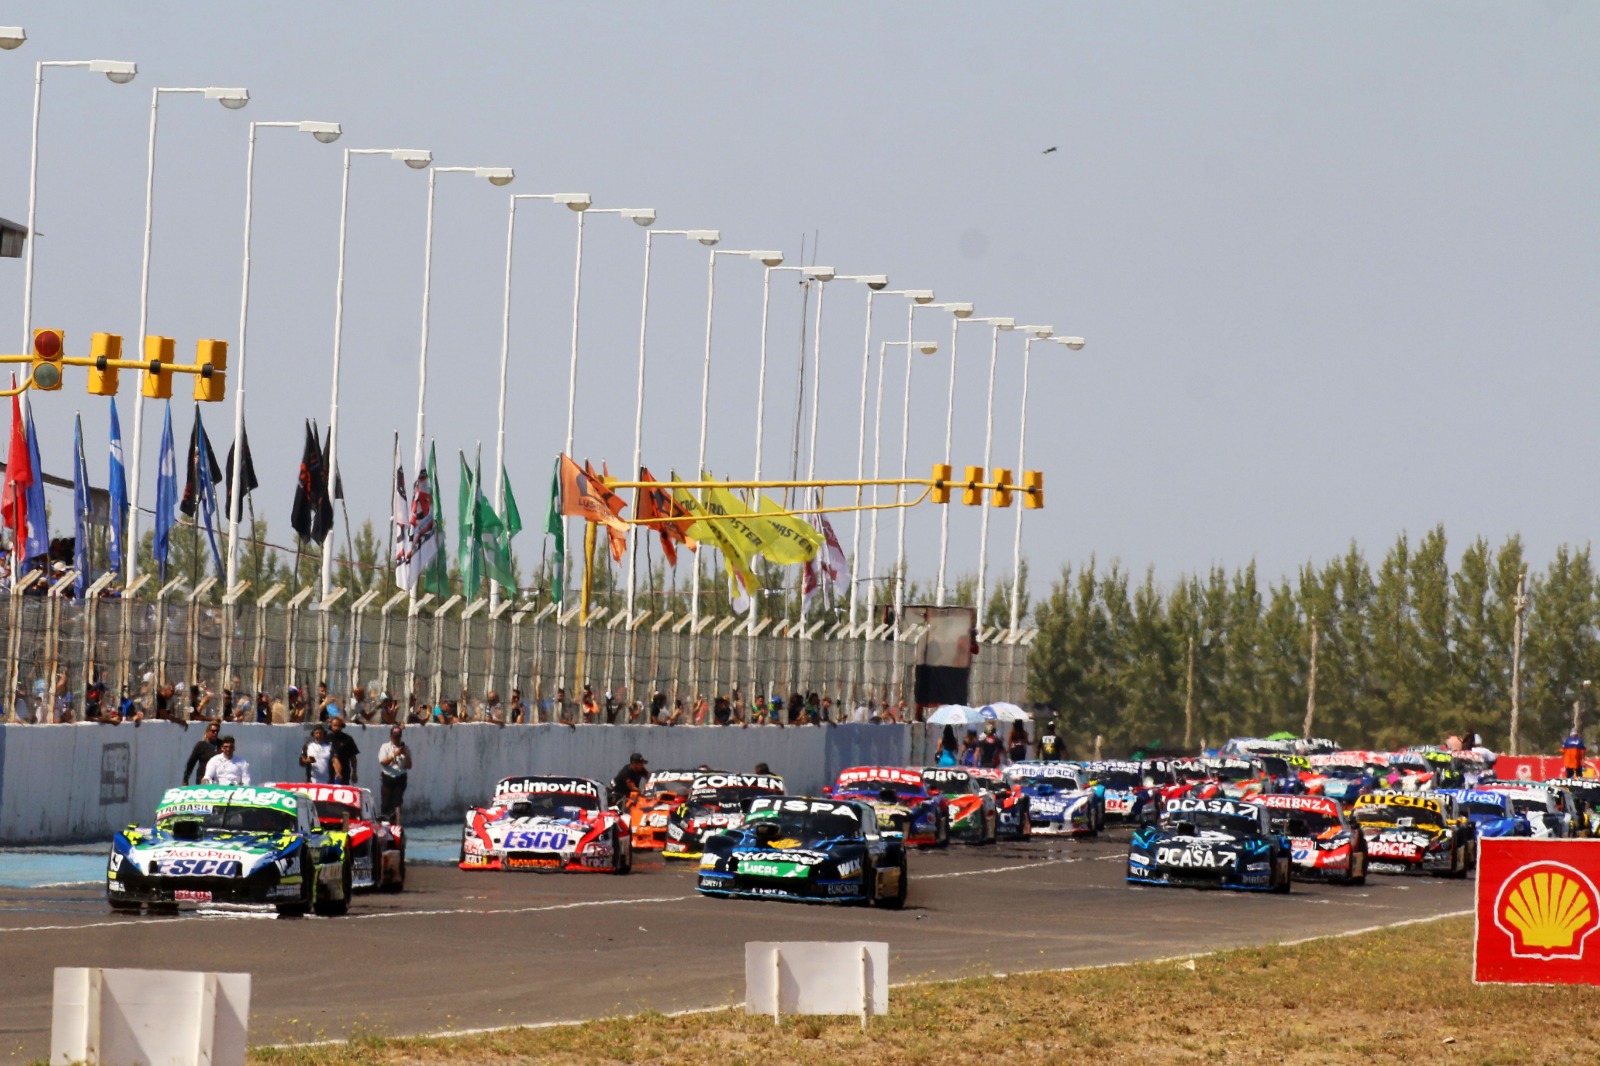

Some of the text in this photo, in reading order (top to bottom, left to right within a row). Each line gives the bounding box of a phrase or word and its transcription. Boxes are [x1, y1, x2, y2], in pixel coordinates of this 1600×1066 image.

[496, 780, 597, 798] Haimovich
[692, 775, 785, 790] CORVEN
[163, 787, 297, 807] SpeedAgro
[1467, 791, 1503, 805] Fresh
[750, 799, 859, 822] FISPA
[1166, 799, 1235, 815] OCASA
[503, 832, 569, 850] ESCO
[1156, 847, 1216, 868] OCASA
[743, 863, 779, 875] Lucas
[837, 859, 862, 877] WIX
